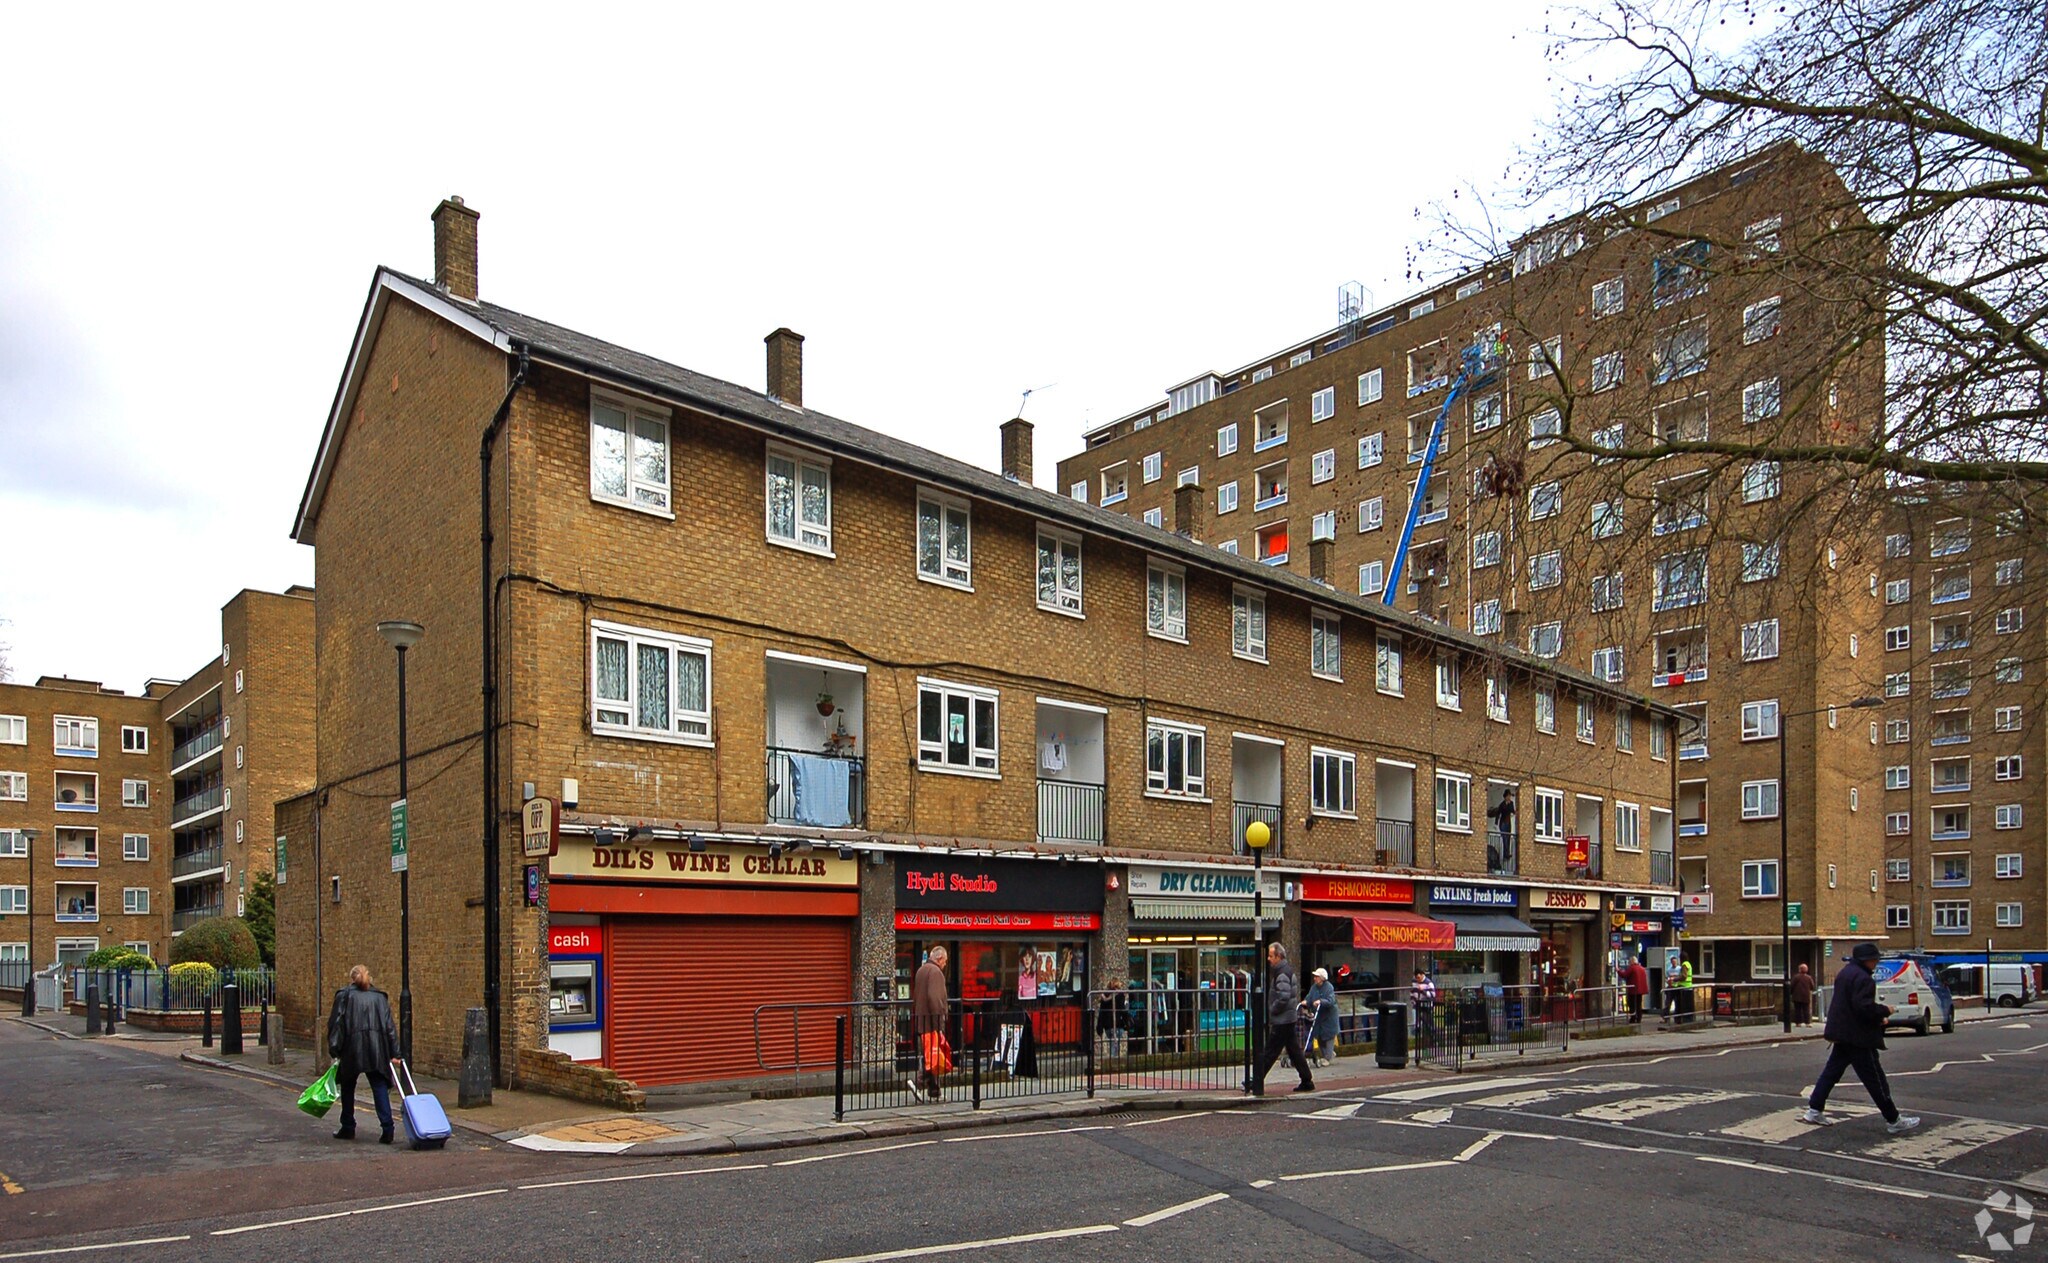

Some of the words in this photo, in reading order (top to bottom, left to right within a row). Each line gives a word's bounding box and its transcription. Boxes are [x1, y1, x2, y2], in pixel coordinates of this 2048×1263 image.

[530, 810, 543, 829] OFF
[592, 847, 654, 869] DIL'S
[666, 851, 730, 873] WINE
[743, 855, 827, 876] CELLAR
[906, 871, 945, 896] Hydi
[950, 873, 998, 893] Studio
[1159, 872, 1189, 891] DRY
[1190, 873, 1256, 894] CLEANING
[1328, 881, 1387, 898] FISHMONGER
[1433, 886, 1472, 901] SKYLINE
[1473, 890, 1491, 903] fresh
[1492, 889, 1512, 903] foods
[1545, 891, 1587, 908] JESSHOPS
[942, 914, 972, 926] Beauty
[974, 914, 991, 925] And
[993, 915, 1010, 925] Nail
[1012, 916, 1031, 926] Care
[554, 931, 590, 947] cash
[1372, 926, 1430, 943] FISHMONGER
